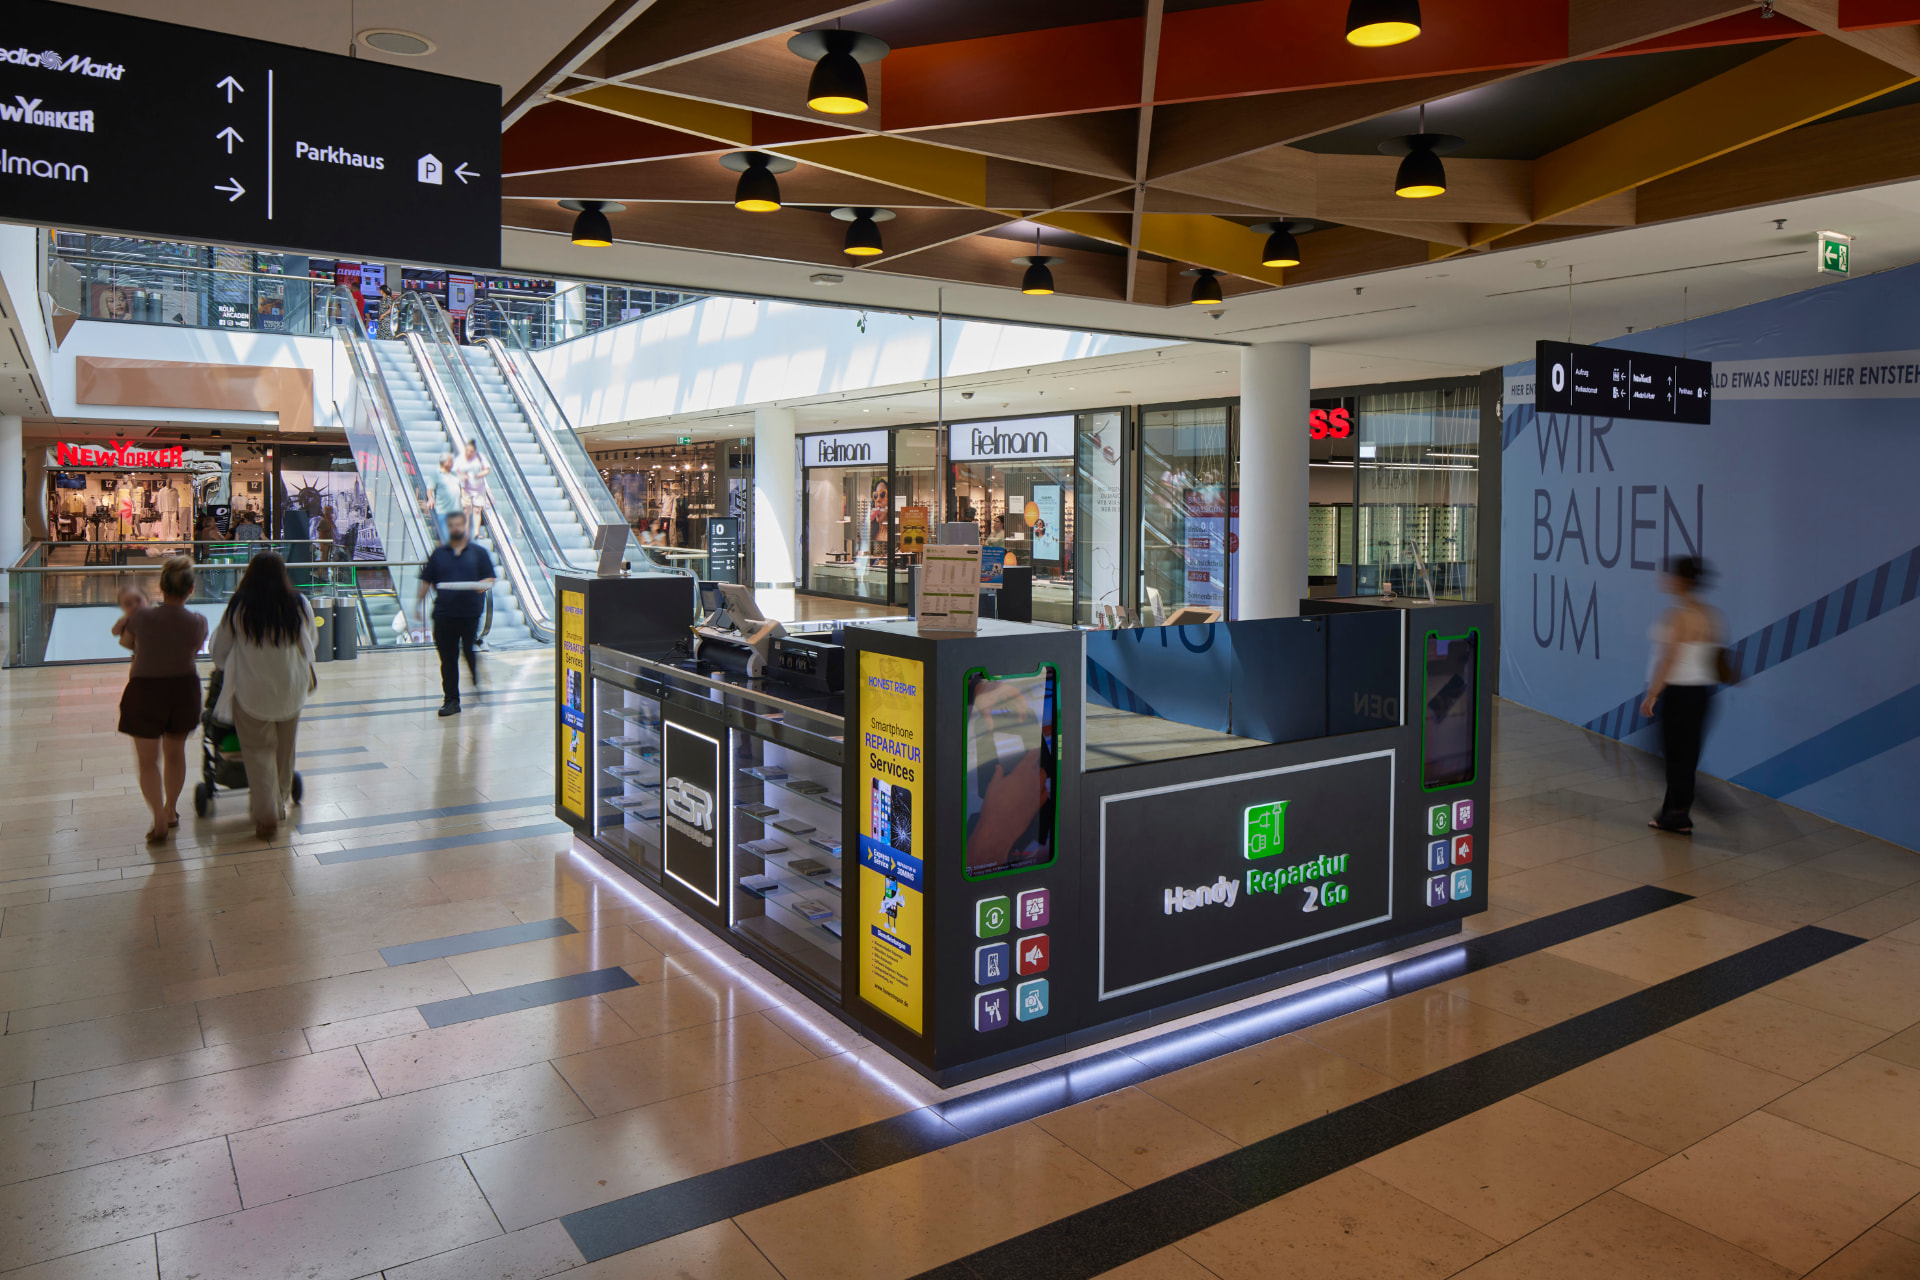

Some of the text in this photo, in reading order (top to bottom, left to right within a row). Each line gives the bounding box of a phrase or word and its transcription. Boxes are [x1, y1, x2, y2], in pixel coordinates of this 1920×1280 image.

[0, 149, 89, 183] lmann
[295, 141, 385, 171] Parkhaus
[1551, 362, 1565, 393] 0
[1731, 371, 1770, 389] ETWAS
[1774, 368, 1819, 387] NEUES!
[1823, 367, 1855, 387] HIER
[818, 438, 871, 463] fielmann
[970, 426, 1048, 456] fielmann
[1534, 412, 1615, 475] WIR
[1534, 484, 1704, 572] BAUEN
[1533, 572, 1600, 660] UM
[868, 675, 894, 692] HONEST
[894, 681, 917, 697] REPAIR
[871, 717, 914, 740] Smartphone
[865, 732, 921, 764] REPARATUR
[870, 752, 915, 783] Services
[1163, 853, 1350, 916] Handy Reparatur
[1302, 880, 1350, 913] 2 Go
